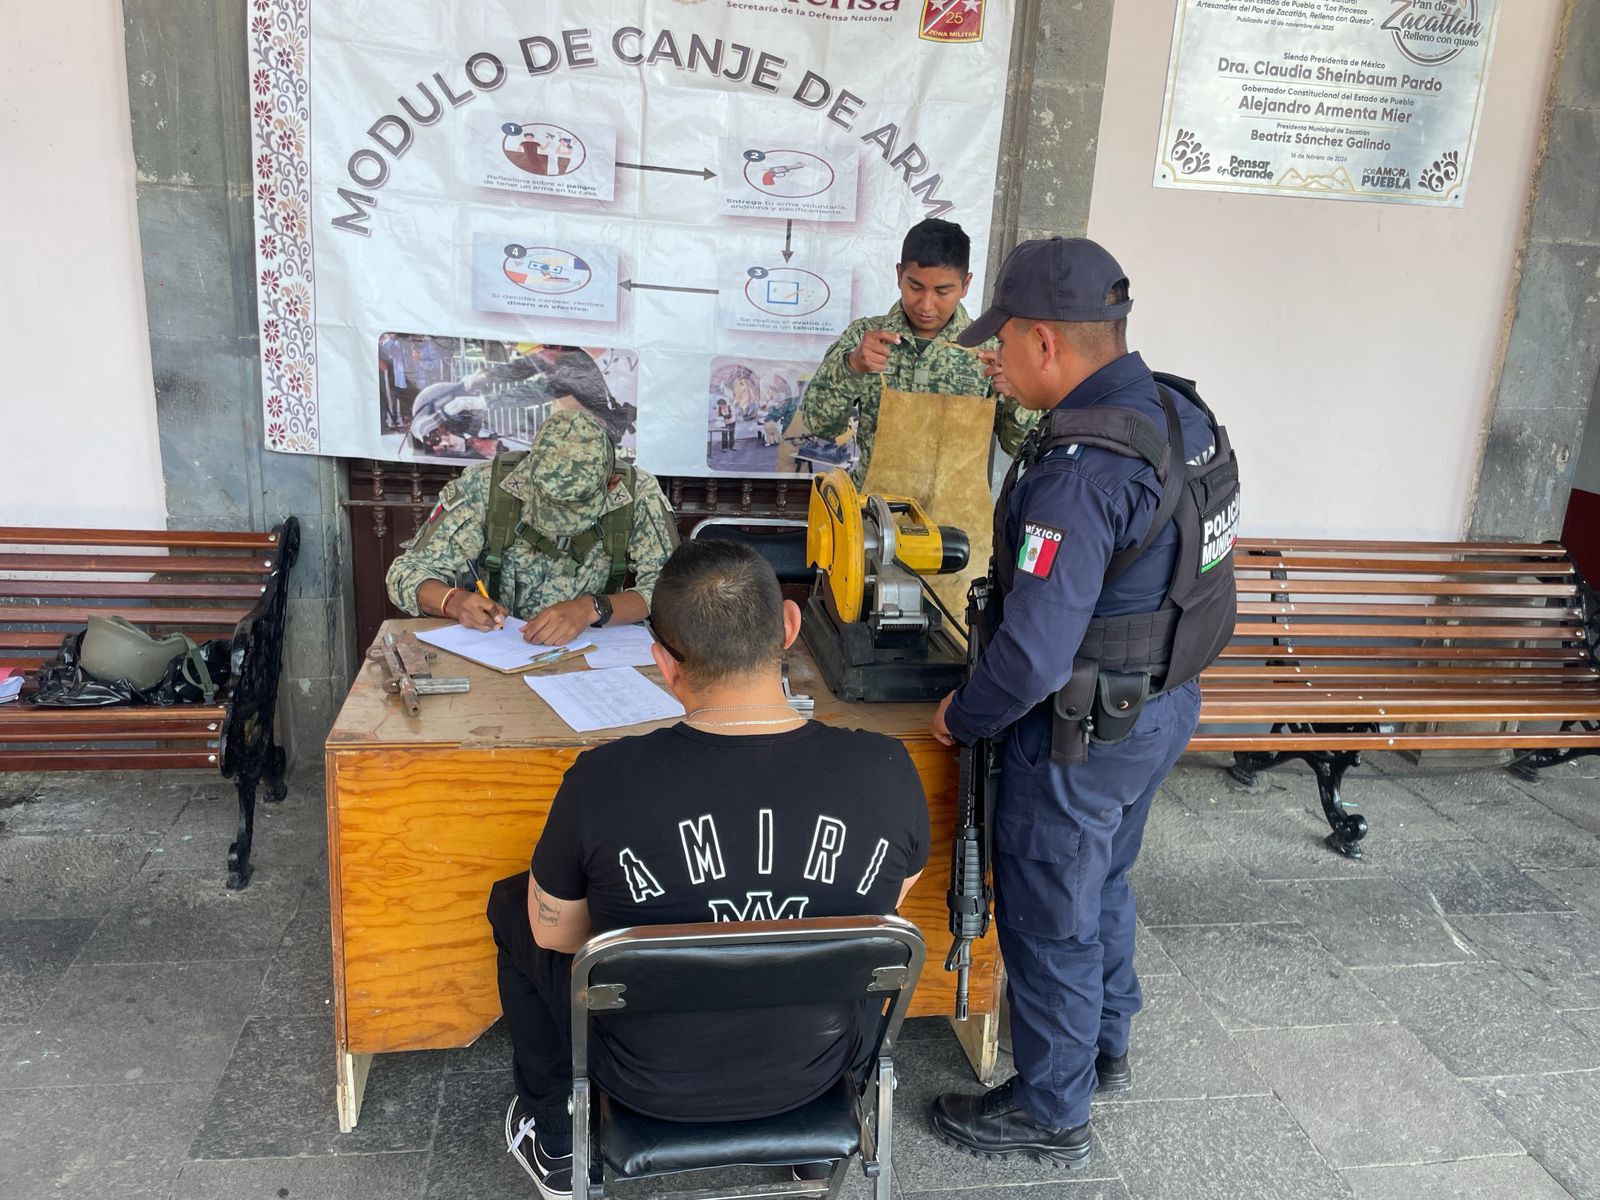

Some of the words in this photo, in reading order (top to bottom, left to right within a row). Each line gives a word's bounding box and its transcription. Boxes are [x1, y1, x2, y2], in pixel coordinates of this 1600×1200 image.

[726, 1, 778, 13] Secretaría
[781, 7, 793, 15] de
[808, 11, 848, 22] Defensa
[1196, 1, 1238, 11] Artesanales
[1250, 6, 1264, 14] Pan
[1265, 7, 1275, 15] de
[1276, 8, 1307, 19] Zacatlán,
[1310, 11, 1334, 21] Relleno
[1292, 0, 1315, 9] Puebla
[1338, 5, 1368, 15] Procesos
[1412, 0, 1432, 10] Pan
[1434, 0, 1447, 12] de
[946, 11, 964, 24] 25
[1236, 16, 1263, 24] Publicado
[928, 29, 948, 37] ZONA
[1403, 30, 1434, 43] Relleno
[1436, 35, 1451, 44] con
[1453, 37, 1479, 48] queso
[1283, 52, 1309, 63] Siendo
[1310, 54, 1348, 66] Presidenta
[1349, 57, 1359, 67] de
[1360, 58, 1386, 69] México
[1217, 57, 1249, 74] Dra.
[1253, 60, 1312, 79] Claudia
[1316, 66, 1398, 88] Sheinbaum
[1400, 74, 1443, 92] Pardo
[1241, 83, 1286, 95] Gobernador
[1288, 88, 1340, 100] Constitucional
[1341, 91, 1353, 101] del
[1354, 92, 1378, 103] Estado
[1379, 95, 1389, 104] de
[1390, 96, 1414, 107] Puebla
[1238, 95, 1311, 115] Alejandro
[1314, 101, 1378, 121] Armenta
[1381, 107, 1412, 124] Mier
[330, 51, 507, 237] MODULO
[518, 27, 597, 76] DE
[611, 26, 788, 94] CANJE
[792, 69, 865, 131] DE
[860, 122, 955, 220] ARM
[1276, 122, 1307, 132] Presidenta
[1308, 124, 1335, 134] Municipal
[1336, 126, 1344, 134] de
[1345, 127, 1370, 136] Zacatlán
[1250, 128, 1292, 144] Beatriz
[1295, 132, 1343, 147] Sánchez
[1346, 136, 1391, 152] Galindo
[1229, 155, 1271, 169] Pensar
[1305, 153, 1325, 161] febrero
[1326, 154, 1334, 162] de
[1230, 166, 1274, 180] Grande
[1375, 166, 1405, 177] AMOR
[486, 174, 530, 184] Reflexiona
[532, 179, 555, 187] sobre
[566, 182, 596, 192] peligro
[496, 180, 519, 188] tener
[1361, 174, 1411, 190] PUEBLA
[726, 198, 762, 206] Entrega
[730, 203, 771, 211] anónima
[511, 247, 519, 257] 4
[502, 294, 536, 302] decides
[506, 300, 536, 308] dinero
[551, 304, 590, 312] efectivo.
[1025, 524, 1062, 542] MÉXICO
[619, 809, 889, 903] AMIRI
